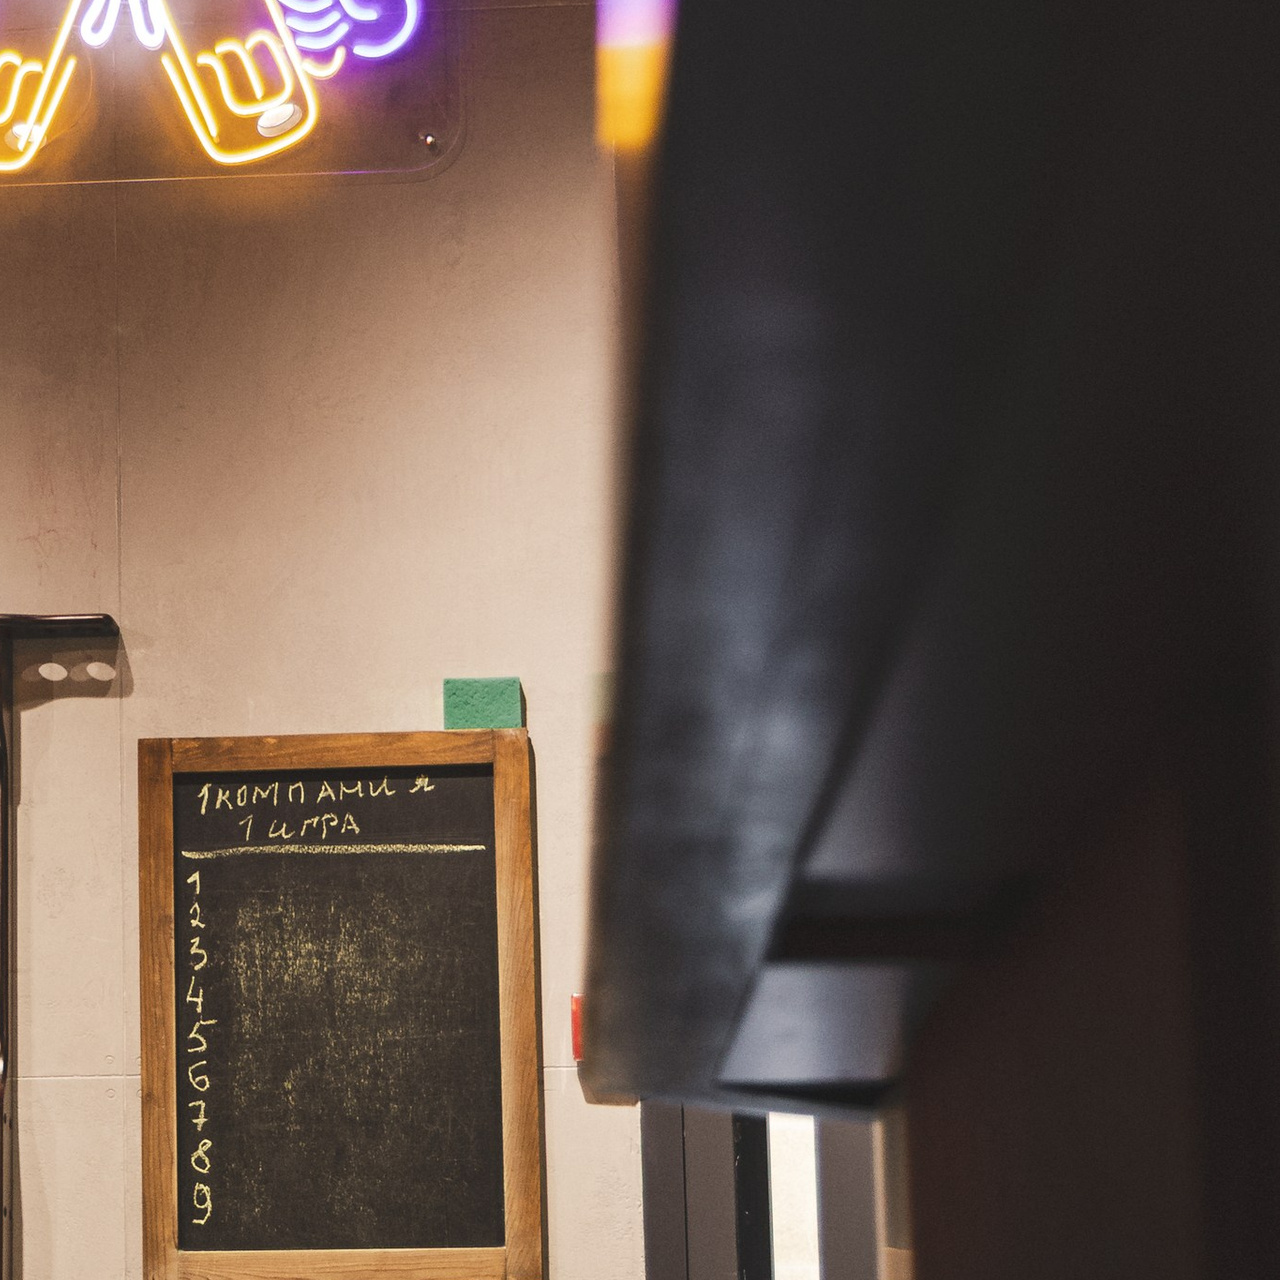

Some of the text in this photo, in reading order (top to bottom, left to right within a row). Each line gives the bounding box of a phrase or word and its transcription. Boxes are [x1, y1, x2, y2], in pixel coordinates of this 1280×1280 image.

[238, 814, 253, 841] 1
[186, 870, 201, 895] 1
[189, 901, 206, 929] 2
[189, 936, 208, 971] 3
[186, 975, 204, 1013] 4
[187, 1019, 218, 1053] 5
[187, 1060, 211, 1092] 6
[188, 1099, 209, 1132] 7
[190, 1138, 213, 1174] 8
[191, 1182, 213, 1226] 9
